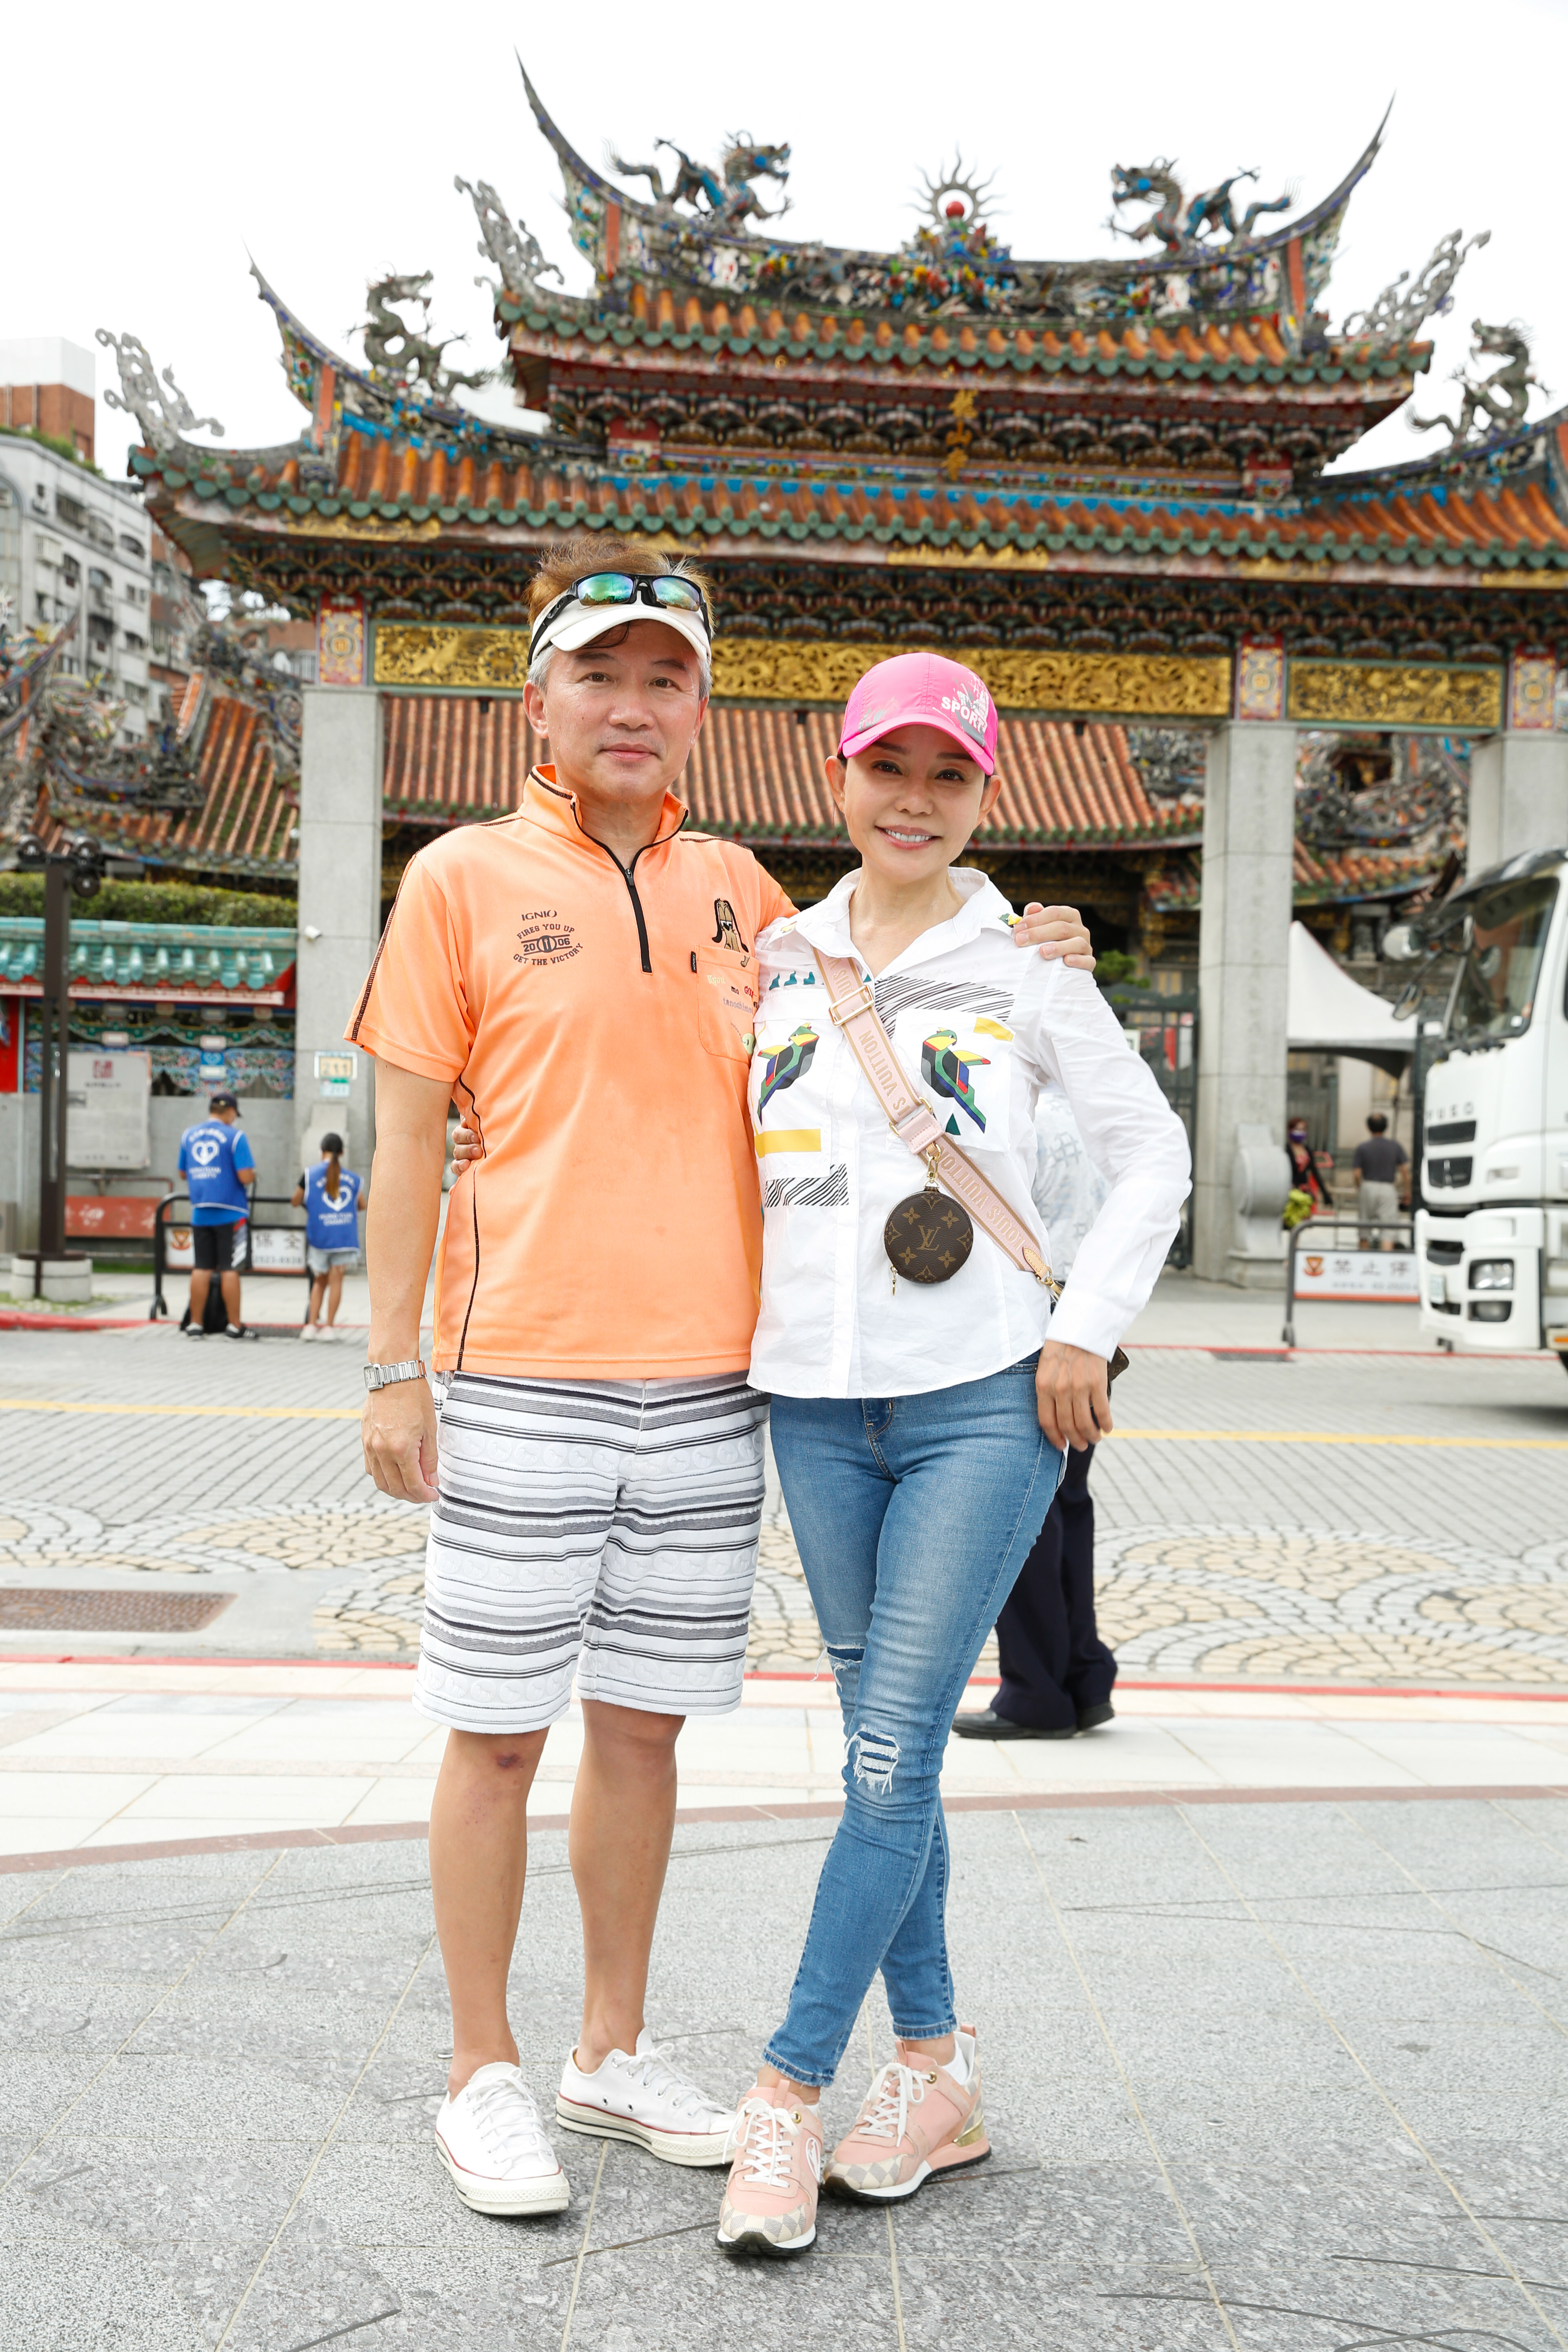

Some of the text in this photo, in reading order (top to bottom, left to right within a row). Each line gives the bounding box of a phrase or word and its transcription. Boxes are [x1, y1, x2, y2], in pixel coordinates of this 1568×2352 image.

[521, 909, 557, 921] IGNIO
[517, 925, 540, 940] FIRES
[564, 925, 575, 933] UP
[513, 953, 529, 964] GET
[550, 942, 583, 964] VICTORY
[707, 975, 726, 986] Kyou
[859, 1030, 898, 1097] VUITTON
[987, 1206, 1025, 1250] LOUIS
